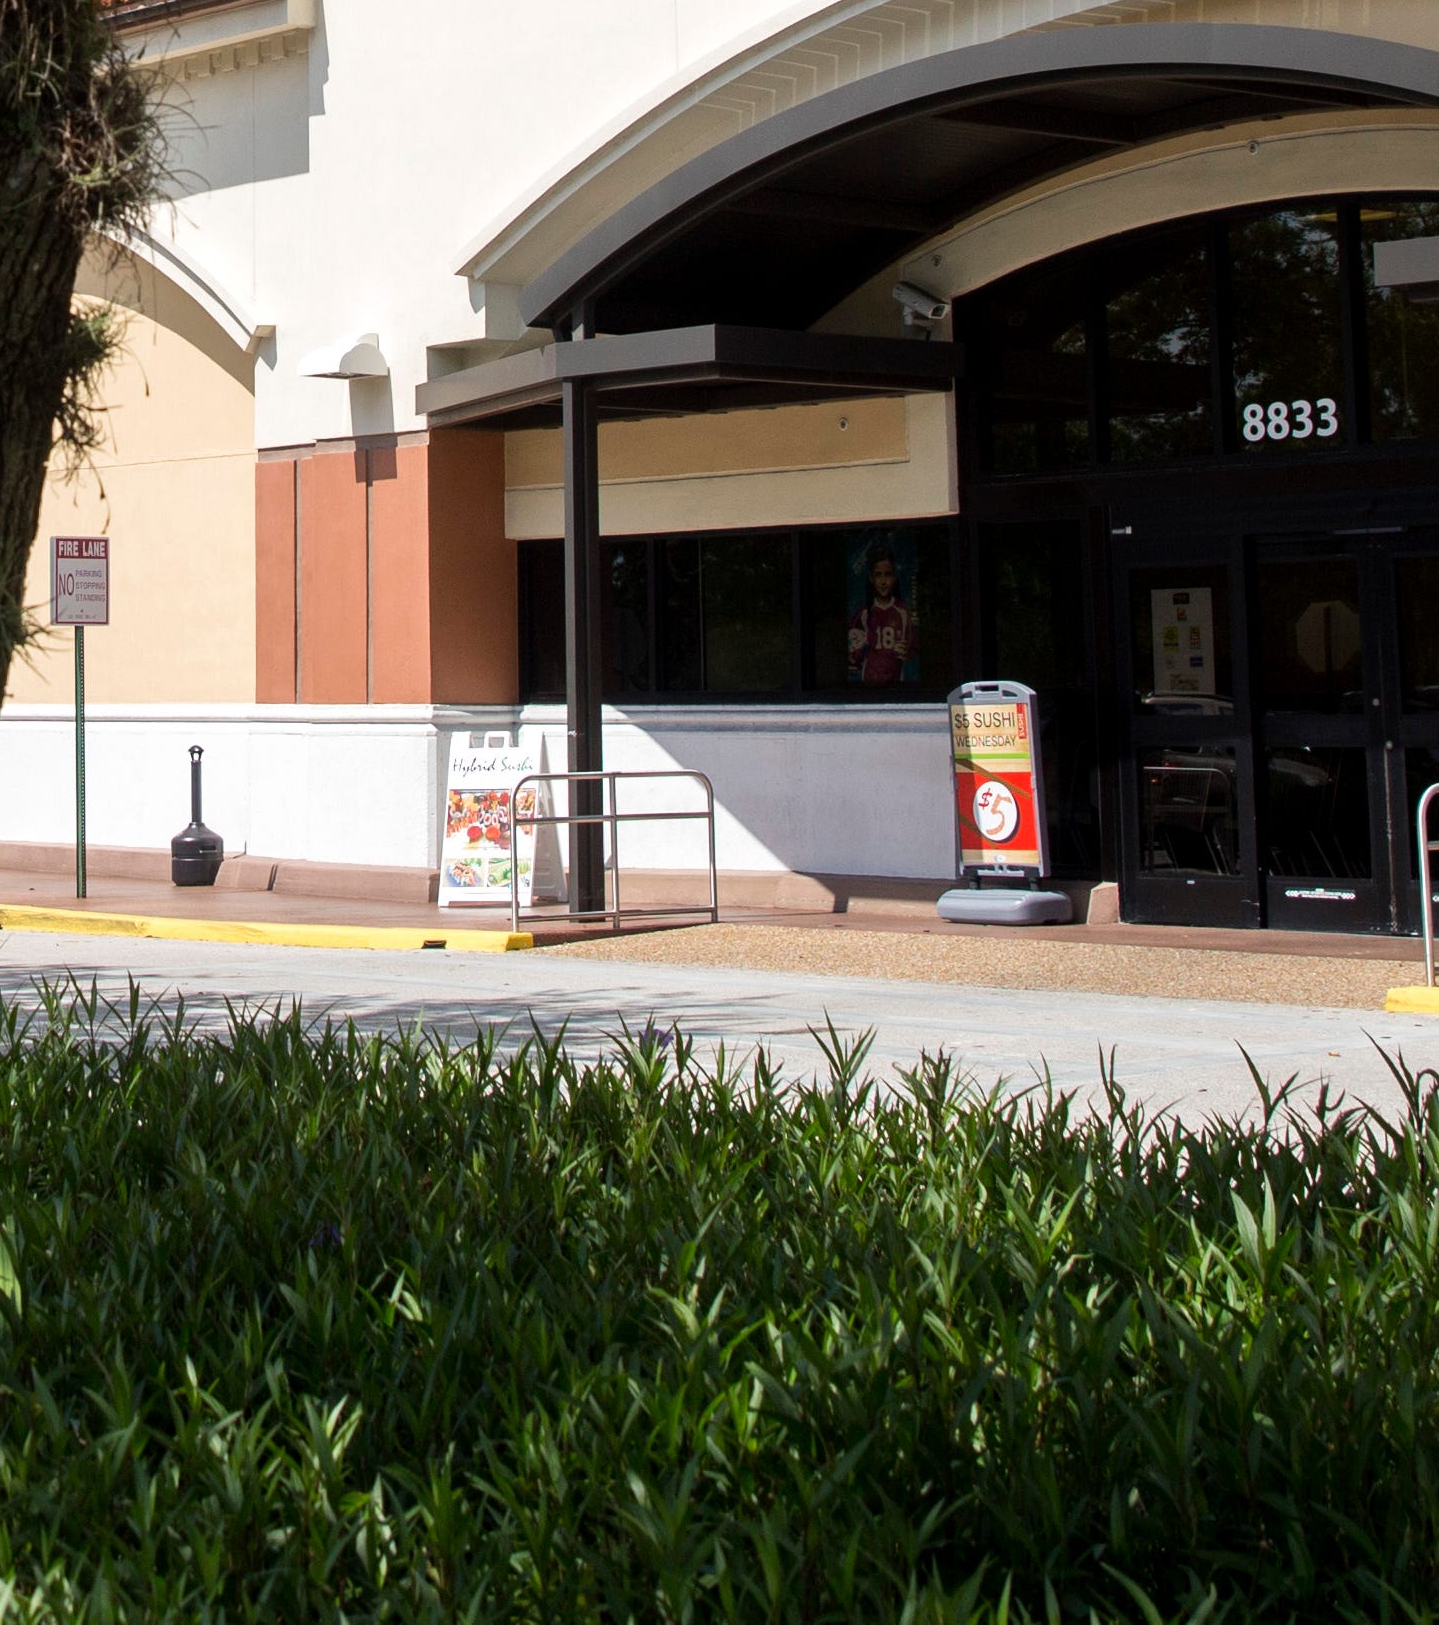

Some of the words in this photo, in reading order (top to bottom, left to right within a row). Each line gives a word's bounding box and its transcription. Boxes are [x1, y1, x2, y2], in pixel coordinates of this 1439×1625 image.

[1242, 397, 1338, 442] 8833
[58, 540, 79, 557] FIRE
[82, 541, 106, 557] LANE
[59, 573, 75, 596] NO
[954, 713, 970, 729] $5
[973, 711, 1016, 728] SUSHI
[955, 734, 1018, 748] WEDNESDAY
[453, 756, 497, 777] Hybrid
[500, 756, 534, 773] Sushi
[977, 786, 1013, 836] $5
